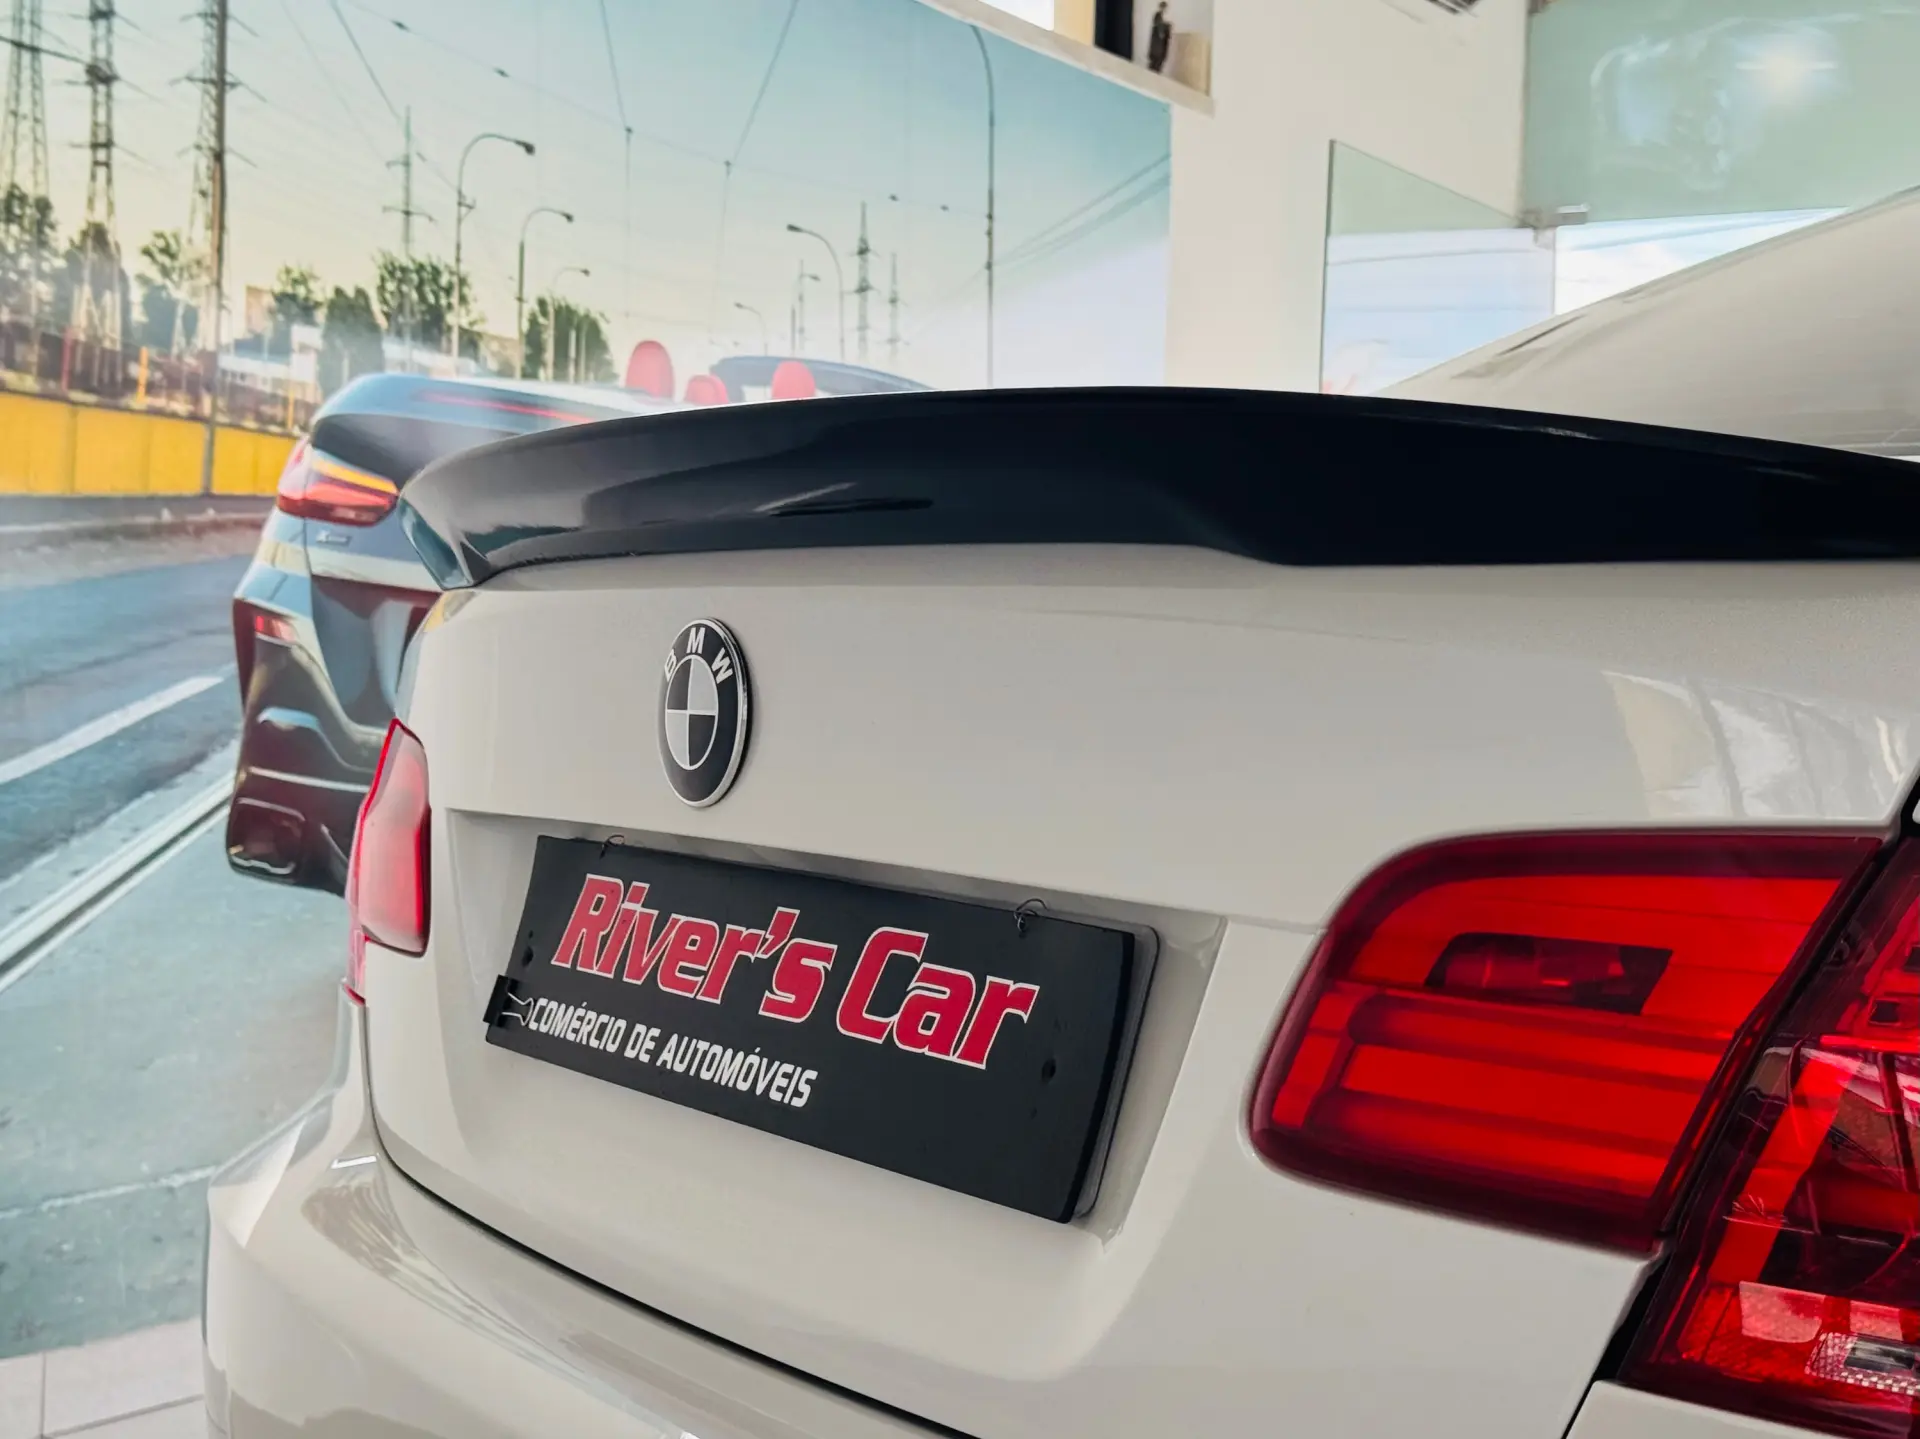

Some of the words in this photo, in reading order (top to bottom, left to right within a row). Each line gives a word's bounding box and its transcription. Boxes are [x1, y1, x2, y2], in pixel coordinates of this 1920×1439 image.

[664, 627, 733, 684] BMW
[551, 873, 837, 1022] River's
[836, 926, 1040, 1069] Car
[528, 997, 627, 1053] COMÉRCIO
[623, 1024, 661, 1063] DE
[656, 1033, 818, 1108] AUTOMÓVEIS
